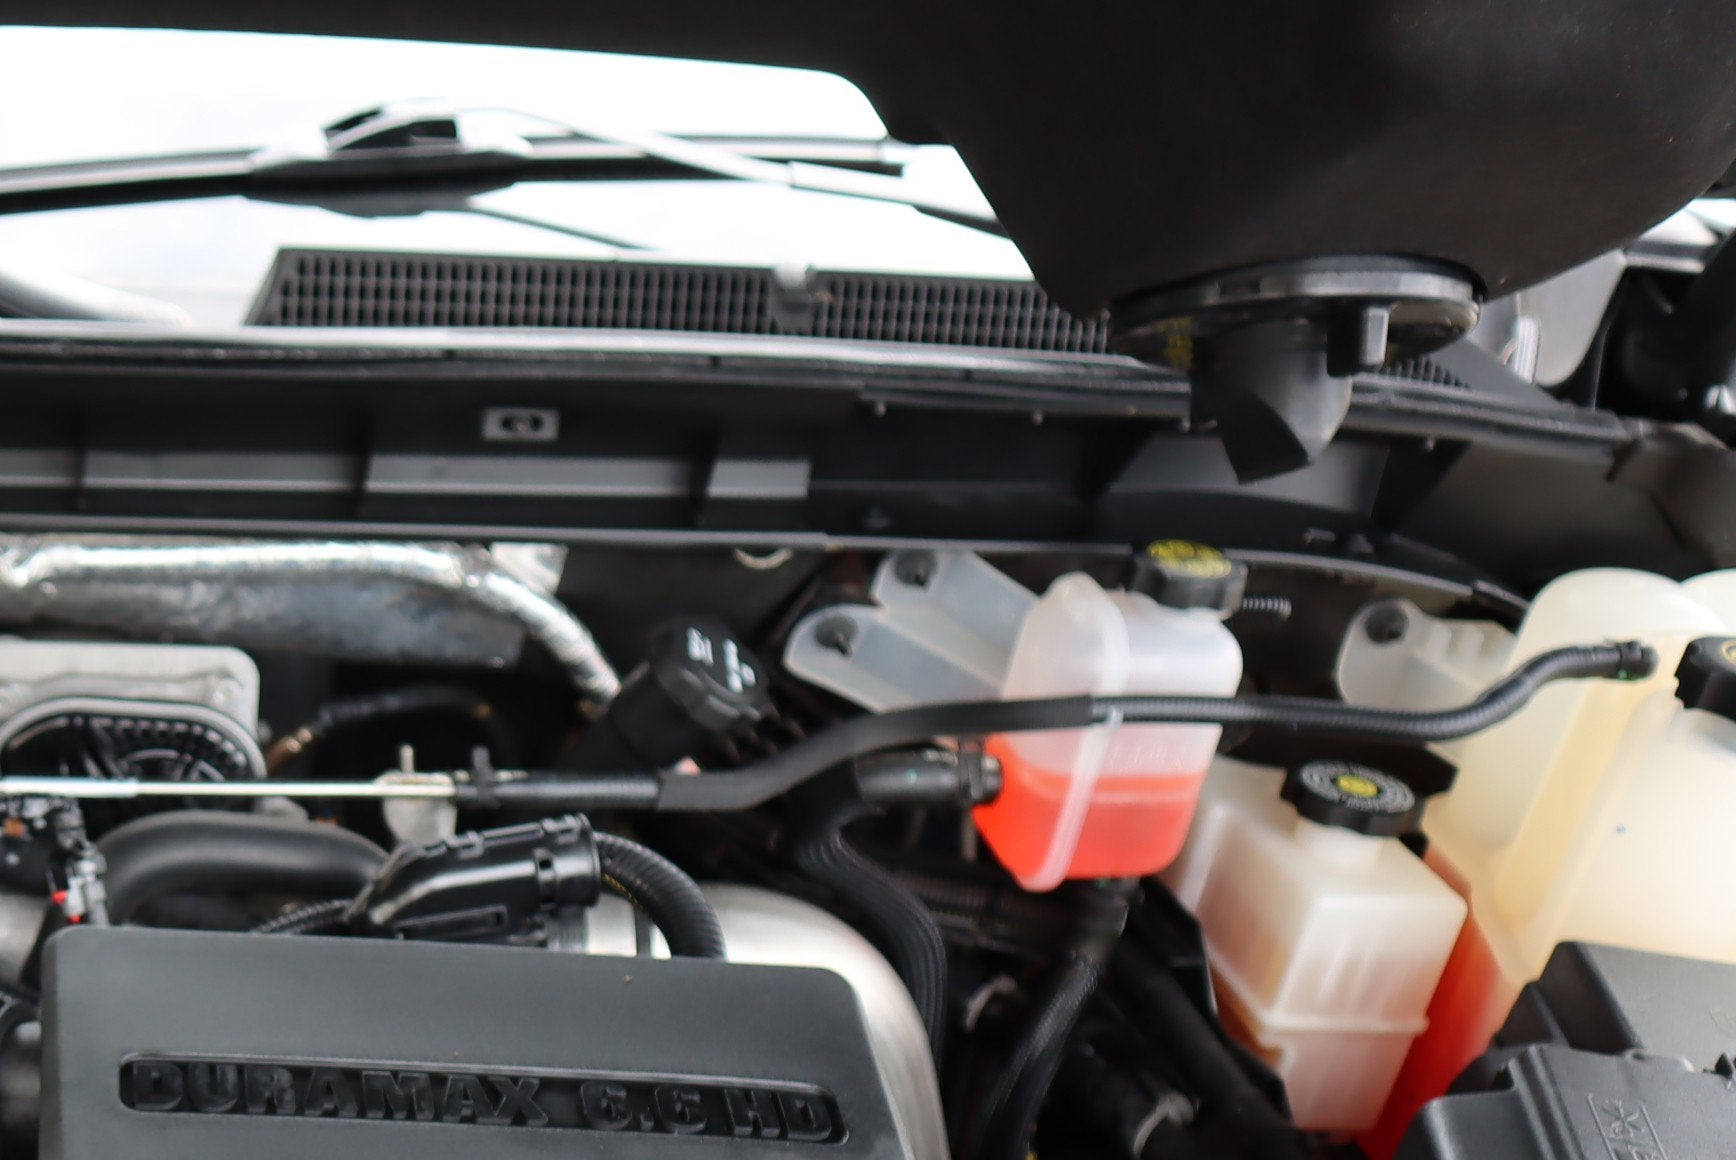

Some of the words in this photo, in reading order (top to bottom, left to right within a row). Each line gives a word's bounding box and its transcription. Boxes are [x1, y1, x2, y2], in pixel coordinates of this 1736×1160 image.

[133, 1063, 550, 1126] DURAMAX
[582, 1083, 707, 1134] 6.6
[724, 1089, 831, 1141] HD
